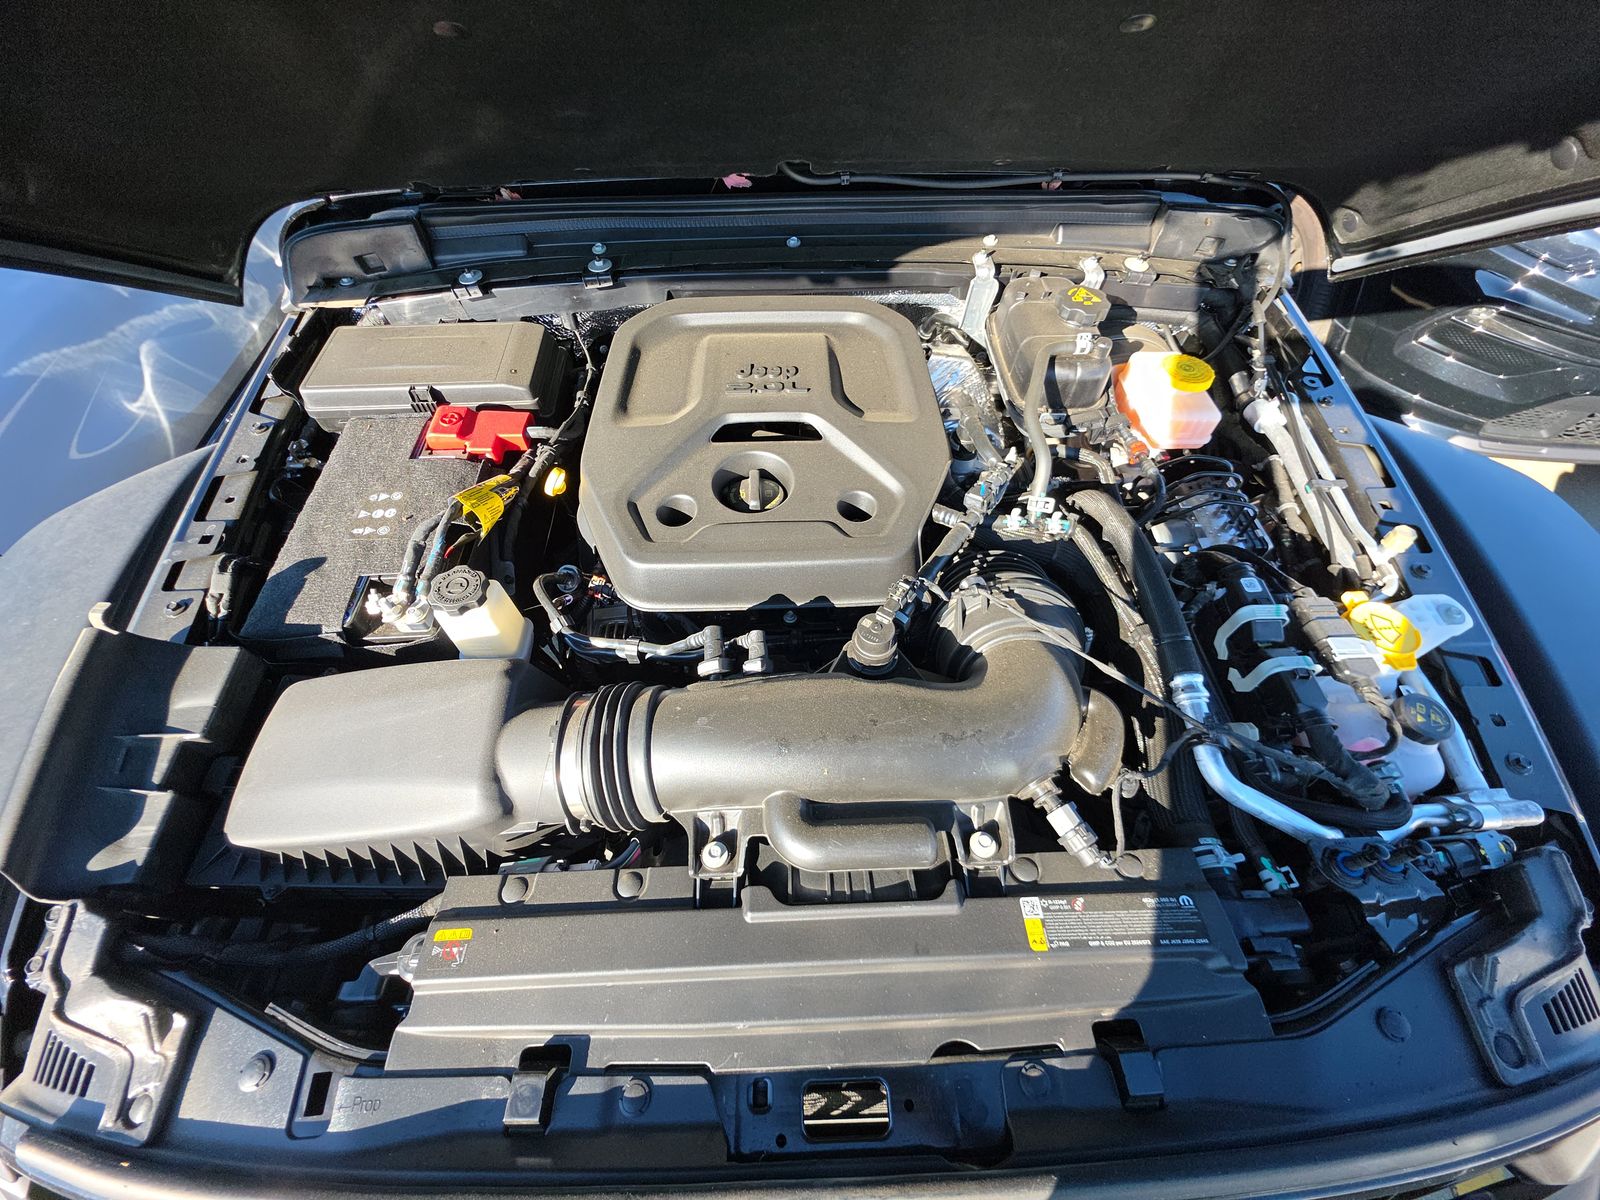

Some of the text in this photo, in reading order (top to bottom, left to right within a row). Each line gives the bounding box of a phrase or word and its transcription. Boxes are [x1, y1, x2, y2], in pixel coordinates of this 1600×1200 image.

[736, 363, 799, 380] Jeep
[725, 381, 811, 396] 2.0L
[352, 1096, 381, 1116] Prop
